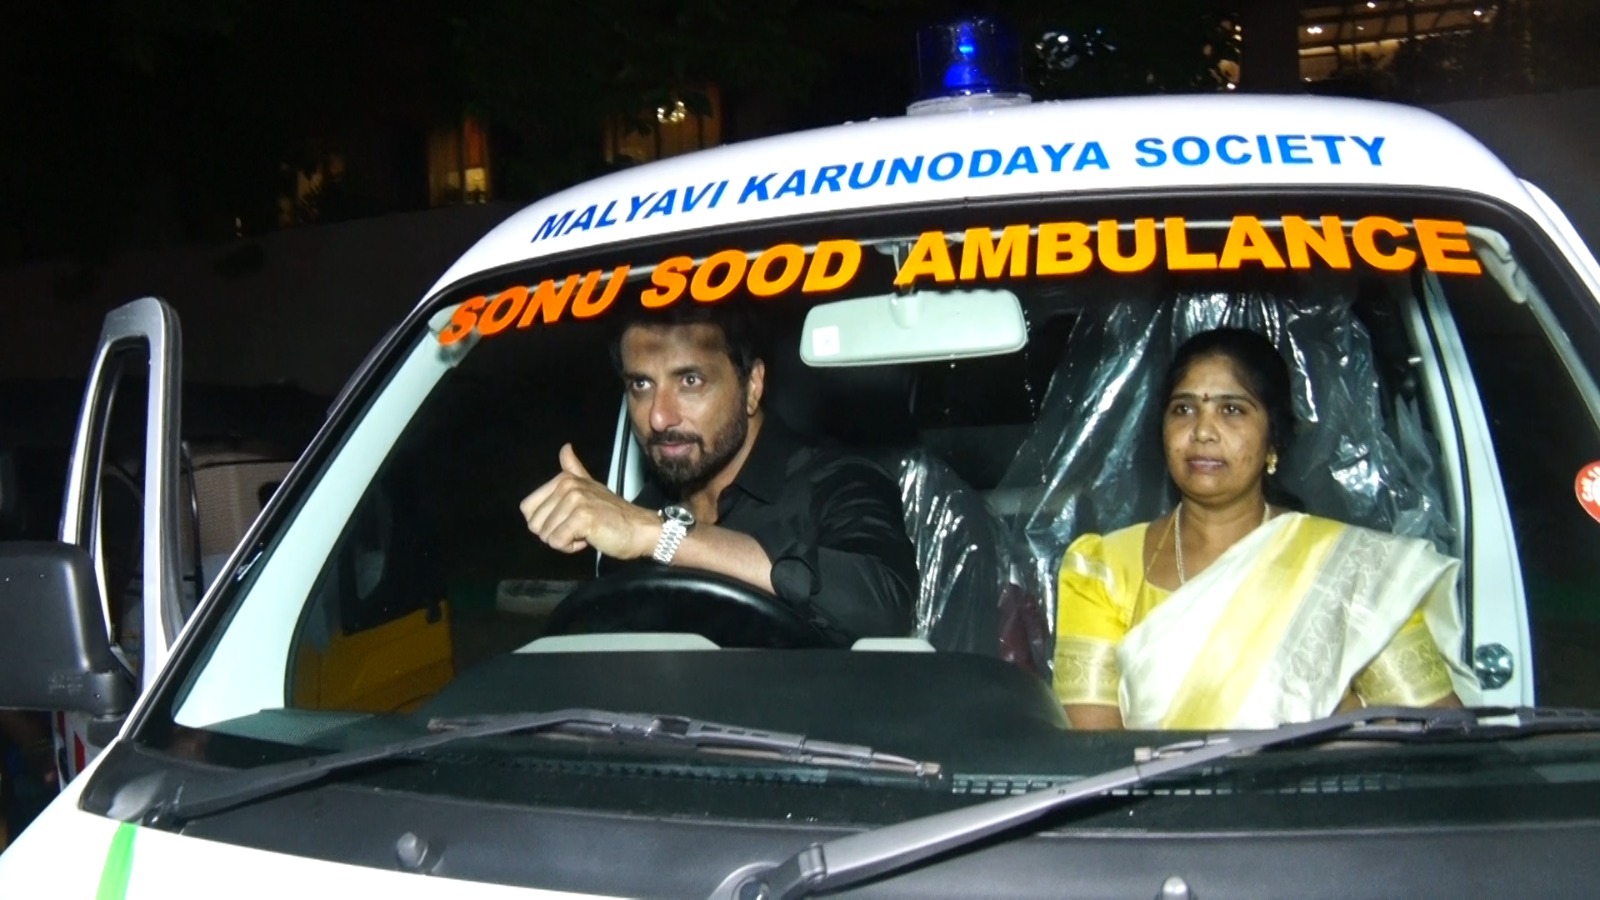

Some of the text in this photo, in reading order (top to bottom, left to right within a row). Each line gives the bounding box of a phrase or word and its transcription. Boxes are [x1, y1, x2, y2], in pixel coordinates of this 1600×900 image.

[531, 135, 1386, 242] MALYAVI KARUNODAYA SOCIETY
[438, 215, 1482, 346] SONU SOOD AMBULANCE
